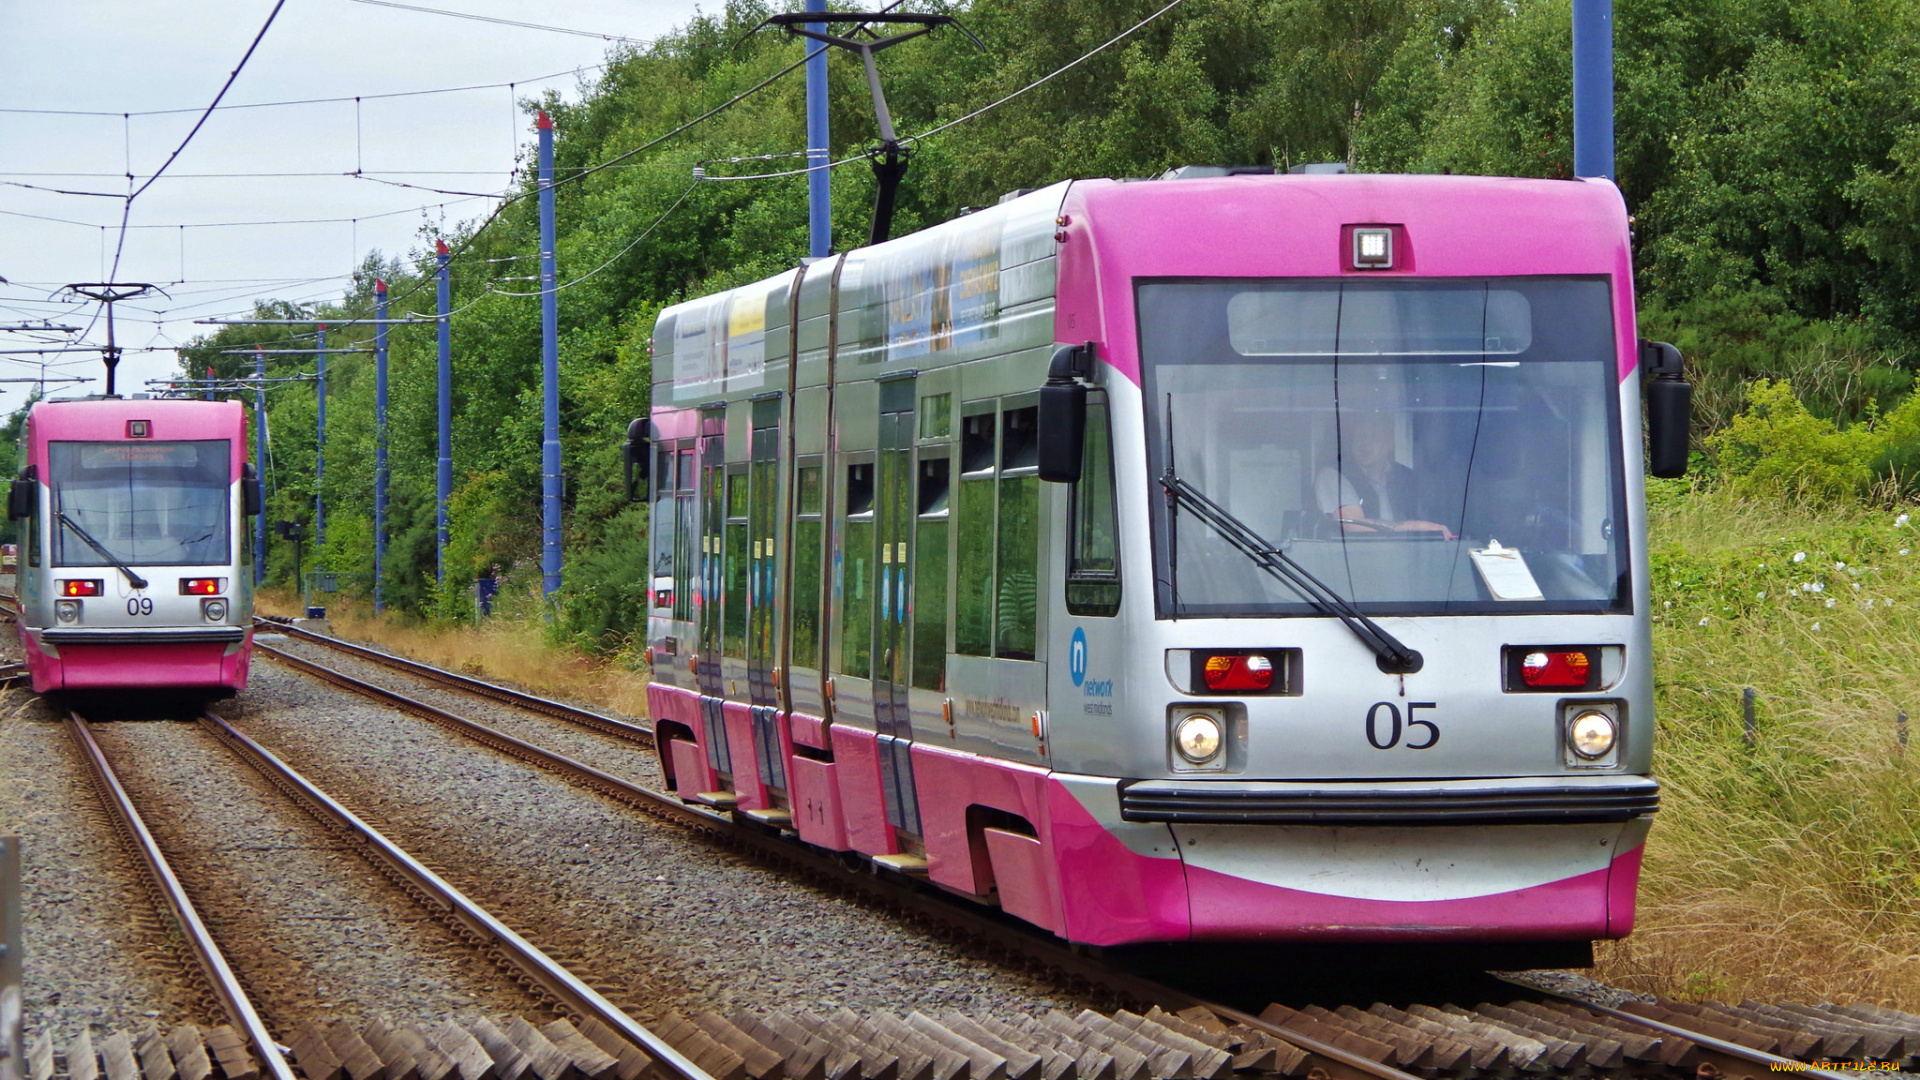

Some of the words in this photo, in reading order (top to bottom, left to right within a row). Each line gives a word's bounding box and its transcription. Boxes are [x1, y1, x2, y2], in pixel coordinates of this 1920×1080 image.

[127, 597, 153, 616] 09
[1073, 641, 1084, 673] n
[1084, 679, 1113, 698] network
[1366, 701, 1440, 750] 05
